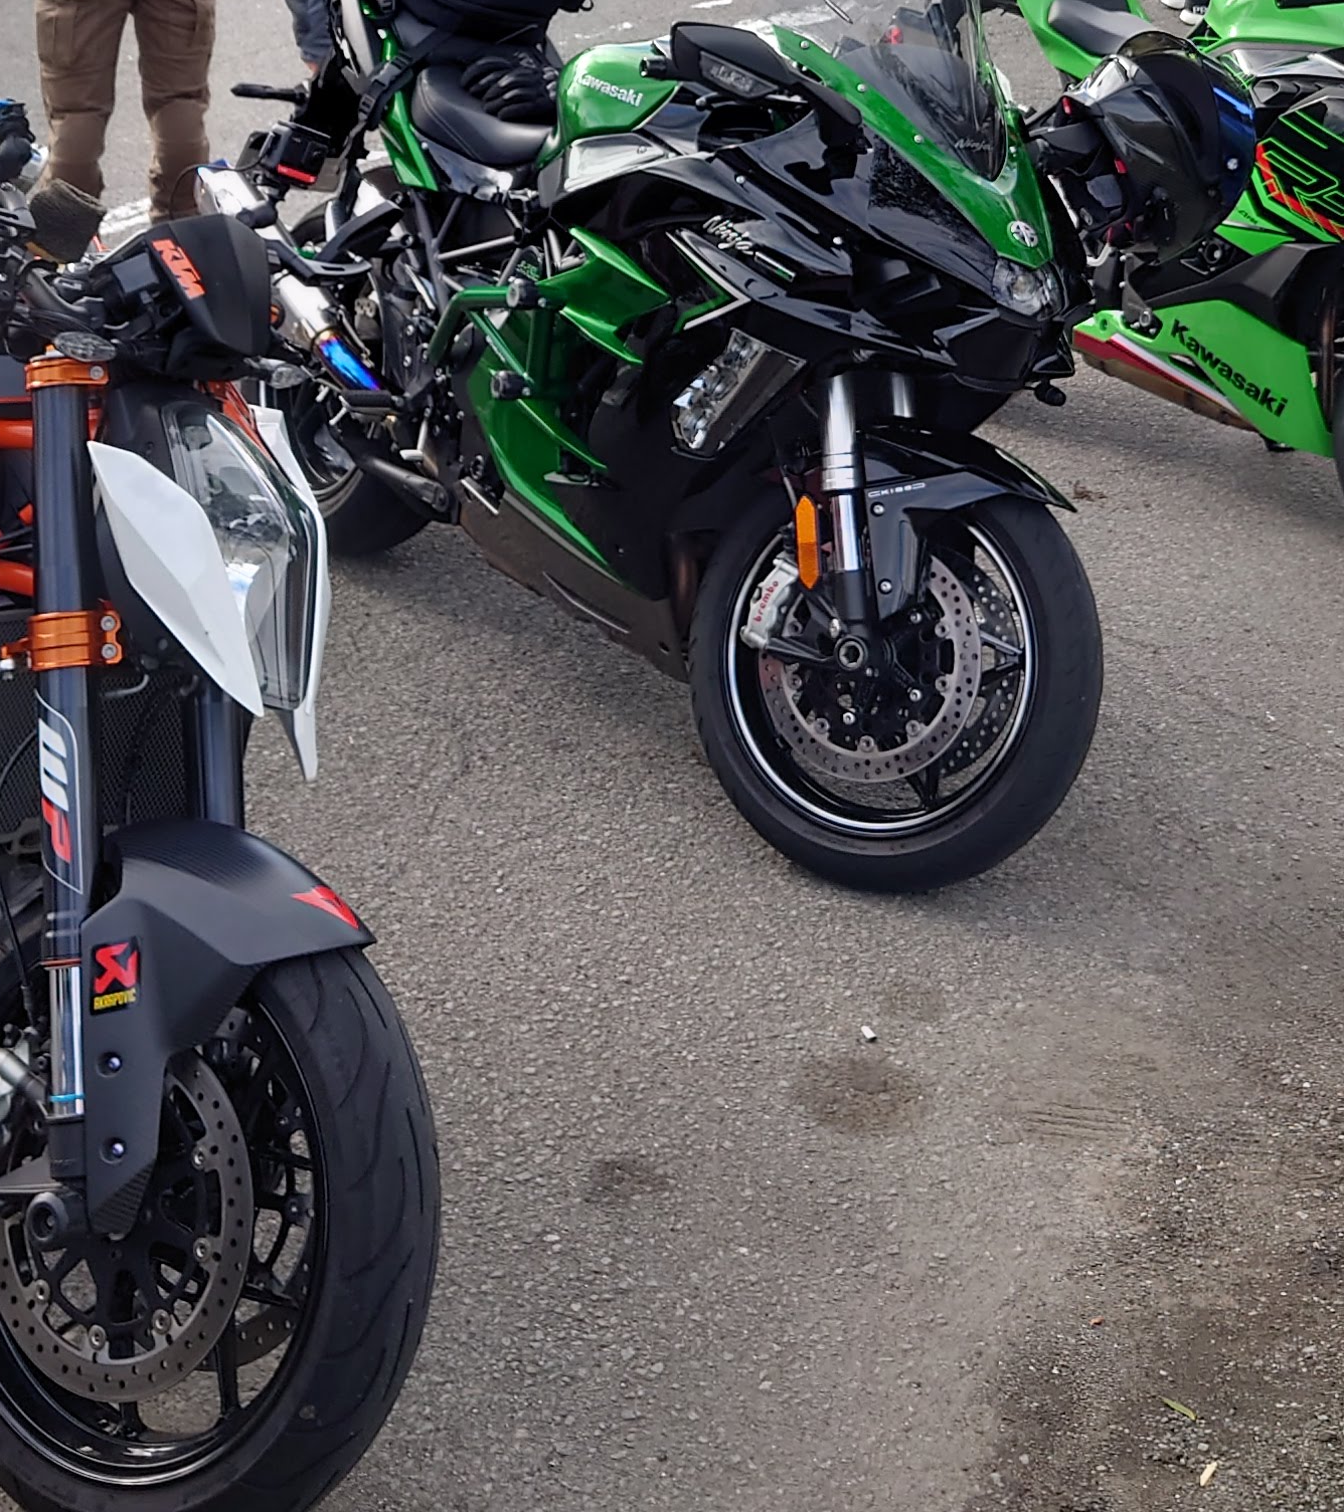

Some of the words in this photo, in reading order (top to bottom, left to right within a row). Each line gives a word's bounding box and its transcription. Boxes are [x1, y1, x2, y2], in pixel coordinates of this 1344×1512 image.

[702, 215, 754, 255] Ninja
[151, 238, 206, 300] KTM
[1171, 318, 1289, 418] Kawasaki
[753, 580, 779, 622] brembo
